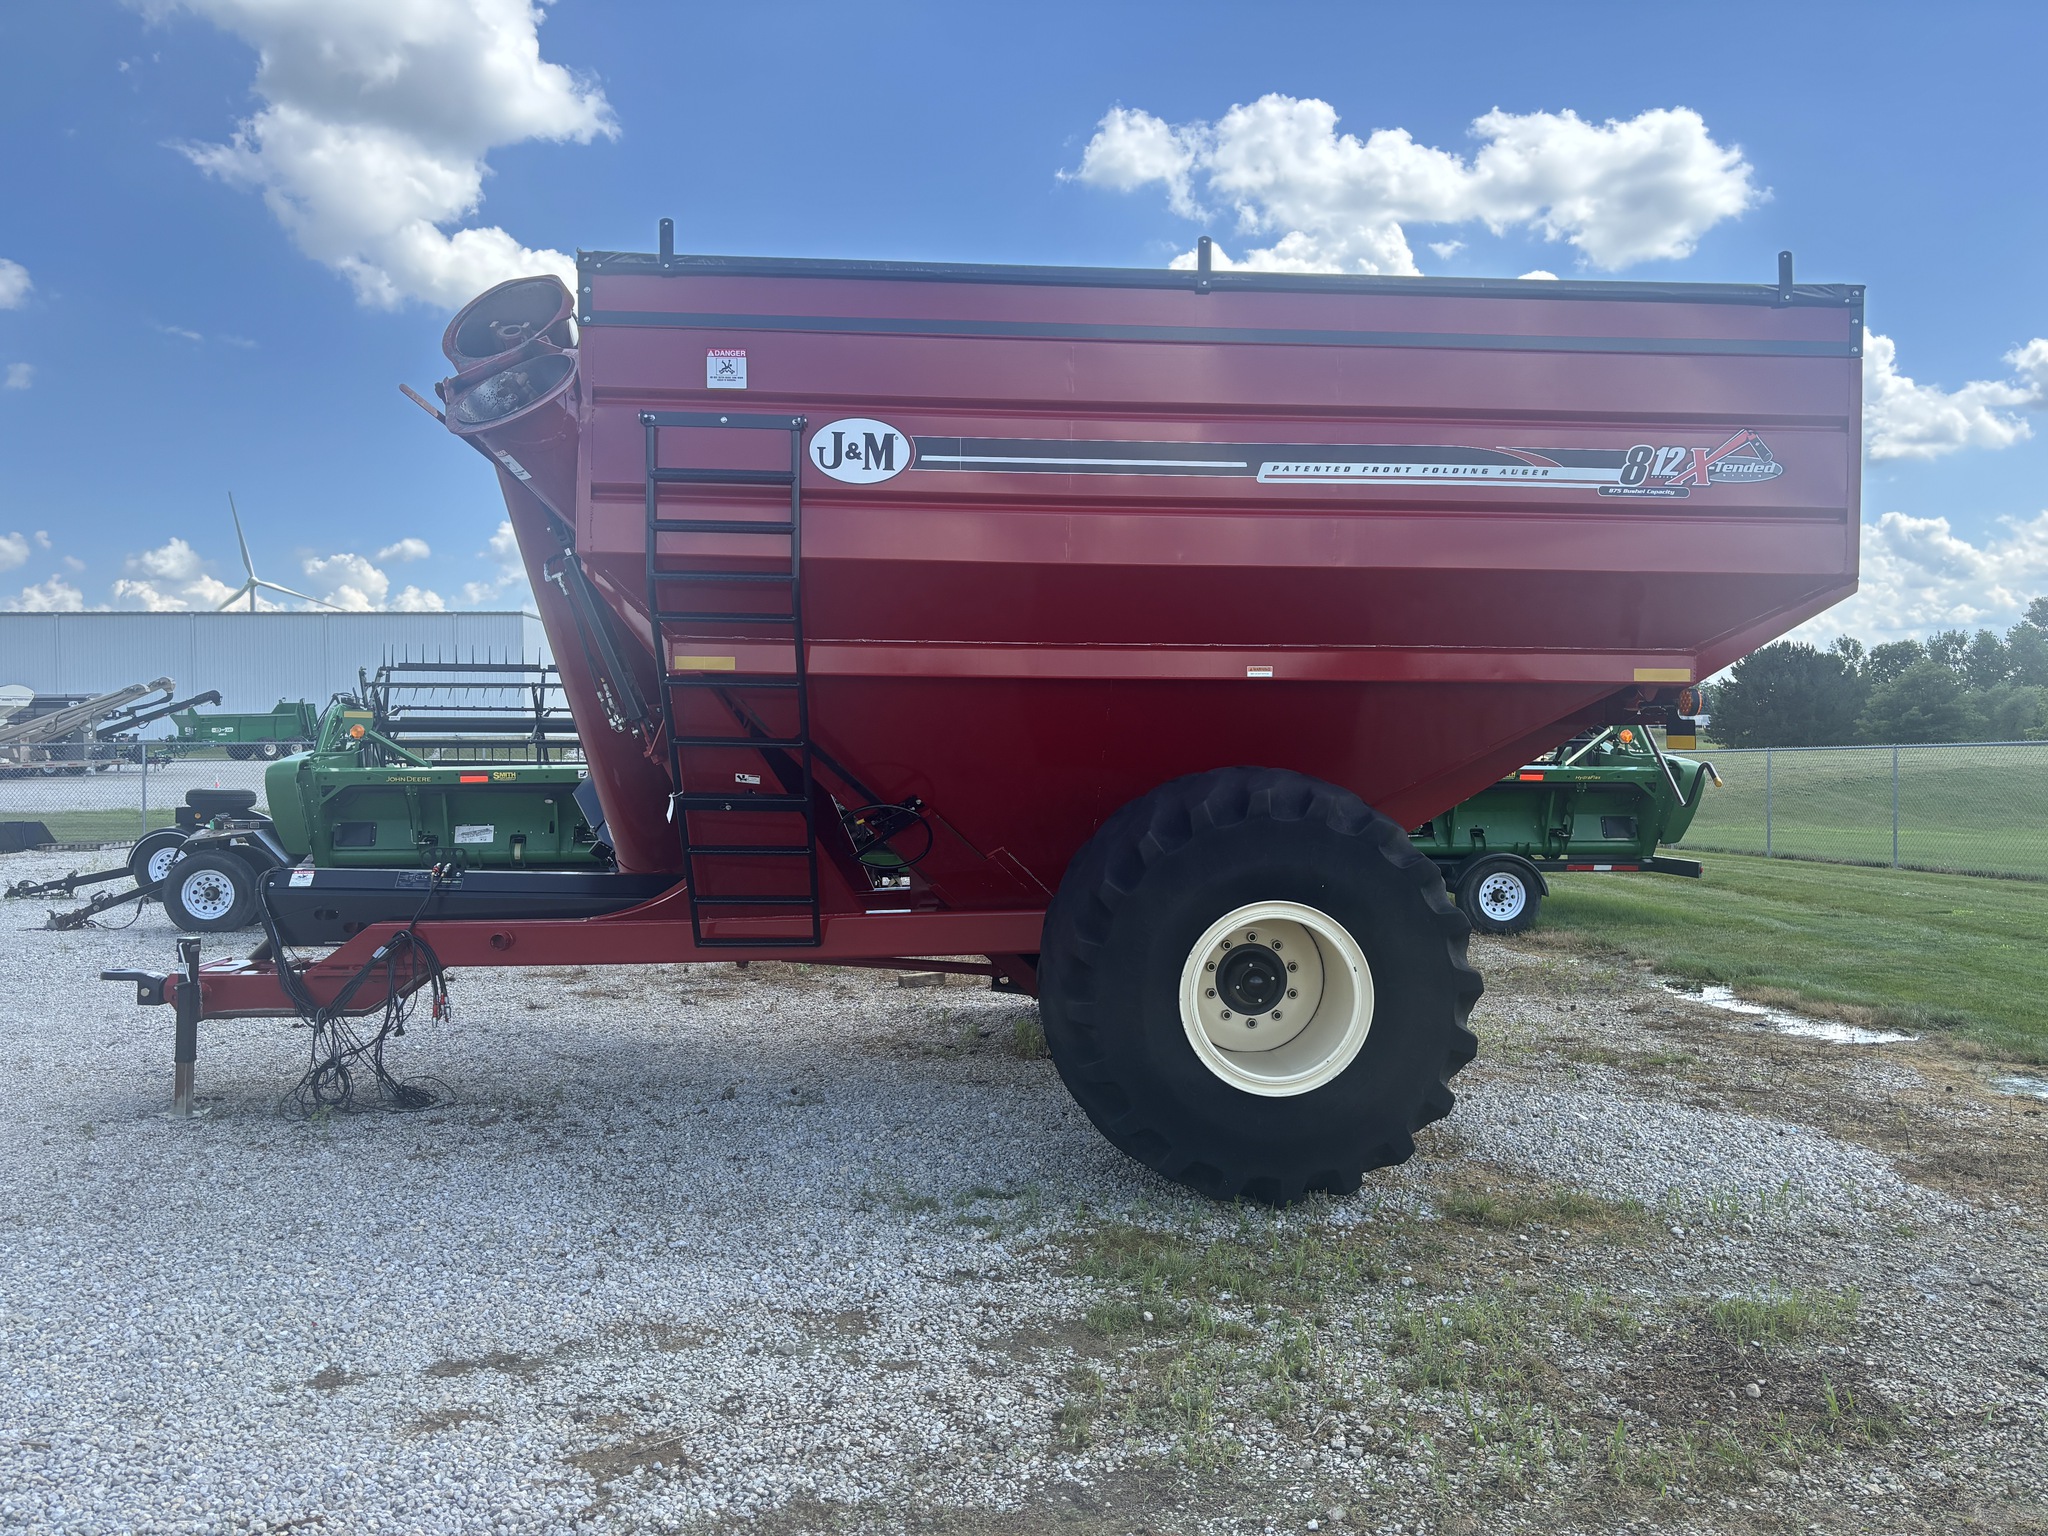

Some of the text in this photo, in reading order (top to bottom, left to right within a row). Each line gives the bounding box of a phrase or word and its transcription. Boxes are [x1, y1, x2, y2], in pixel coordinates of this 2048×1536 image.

[816, 431, 897, 471] J&M
[1271, 464, 1551, 476] PATENTED FRONT FOLDING AUGER
[1617, 444, 1688, 487] 812
[493, 771, 516, 779] SMITH
